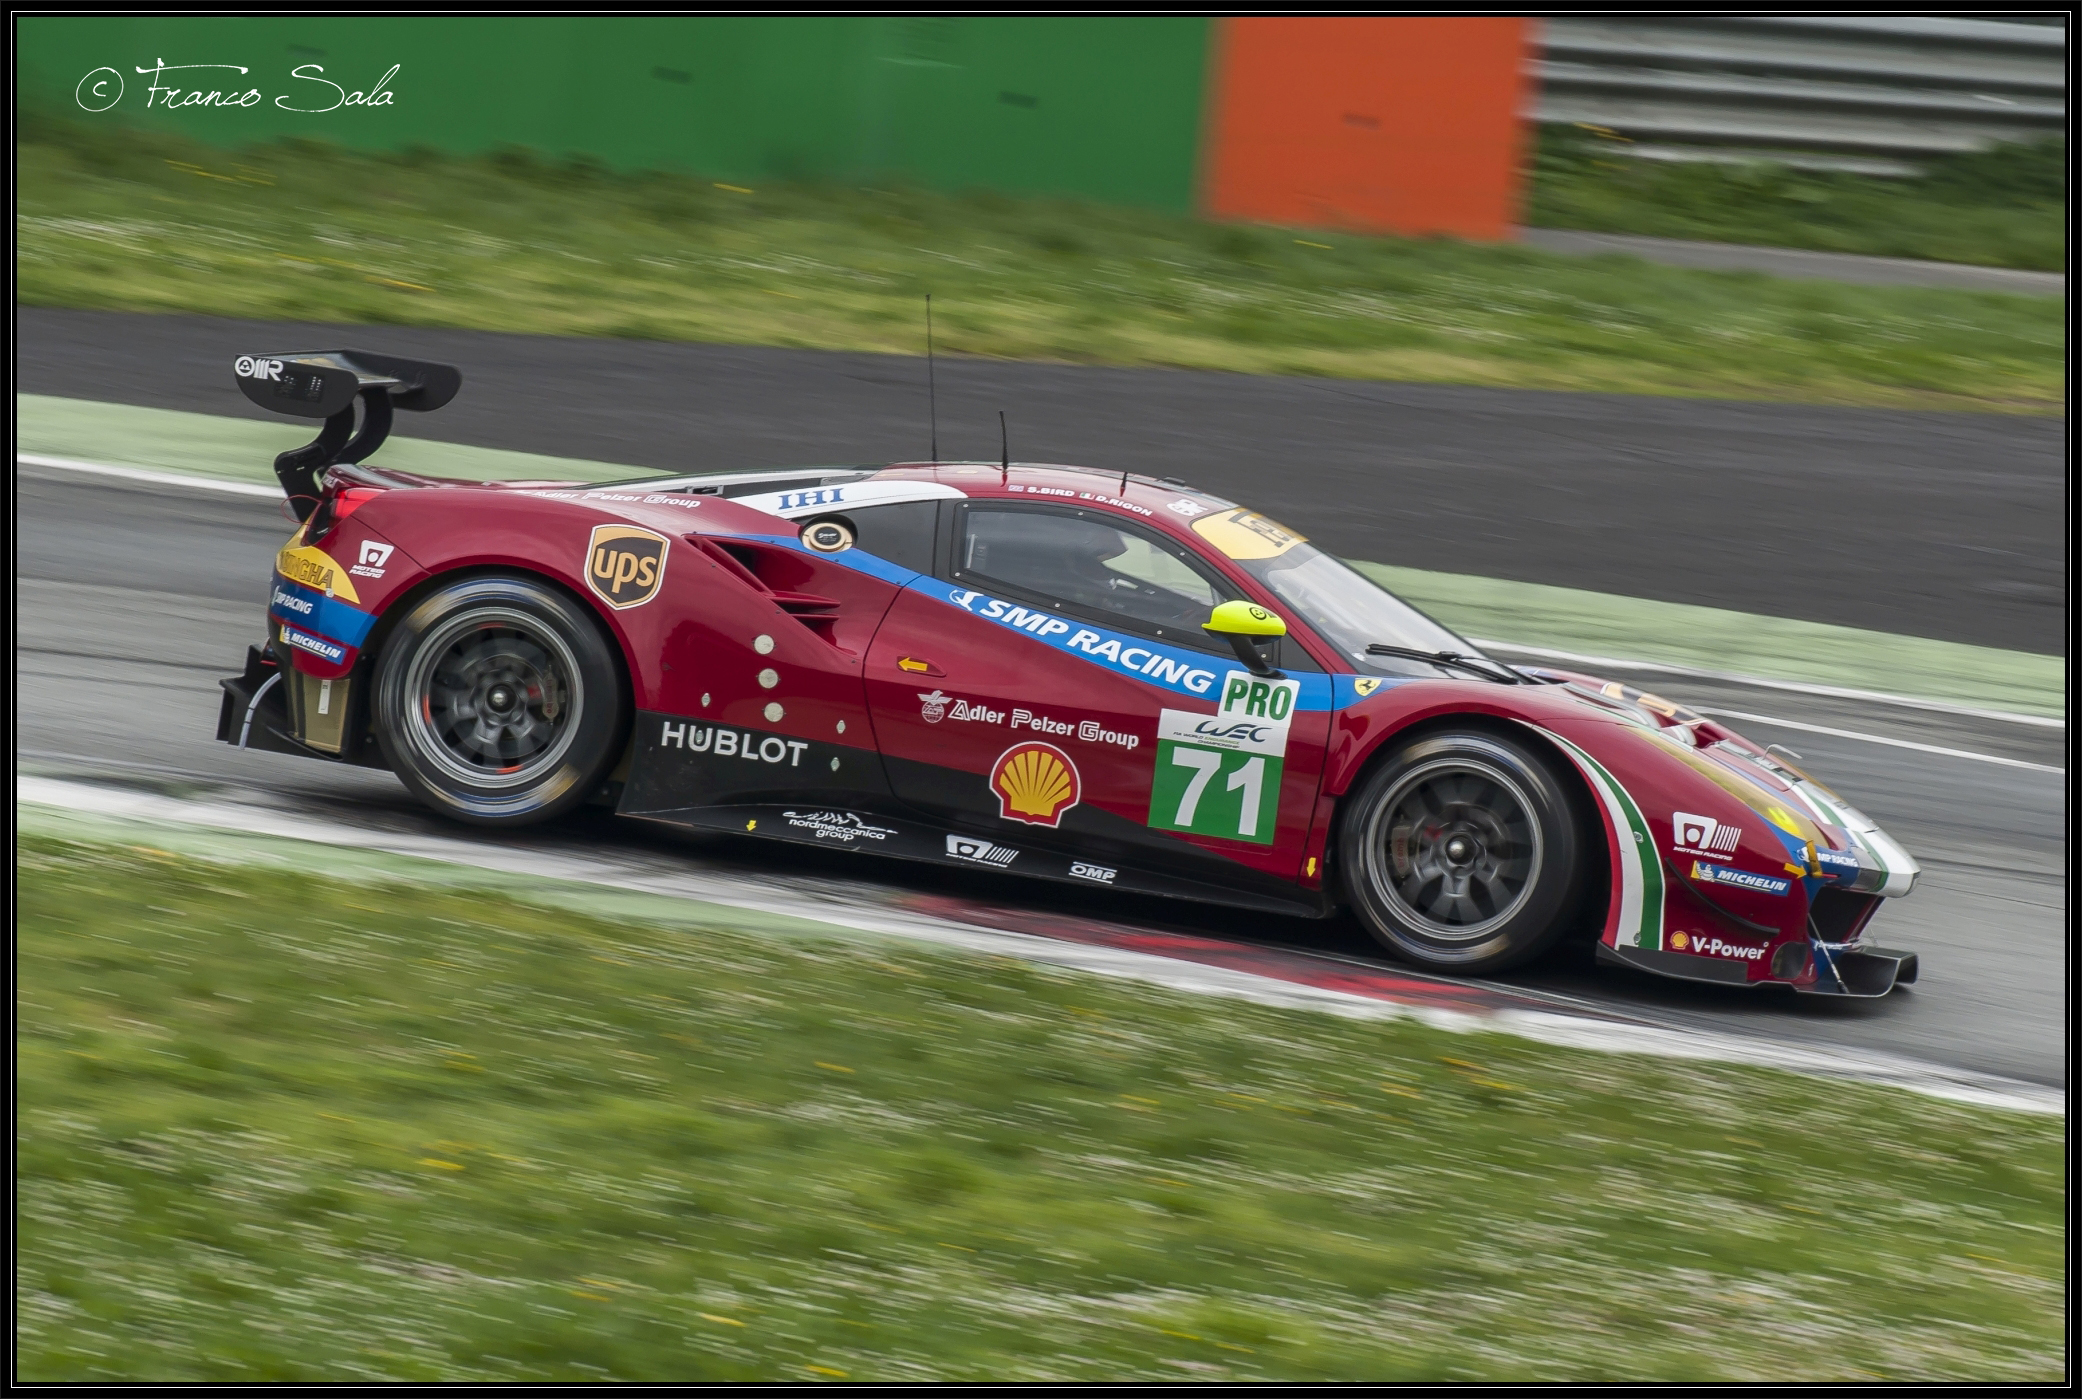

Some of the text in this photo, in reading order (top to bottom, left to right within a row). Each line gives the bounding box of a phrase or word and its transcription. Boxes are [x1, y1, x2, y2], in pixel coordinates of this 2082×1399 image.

[643, 494, 702, 508] Group
[778, 488, 844, 510] IHI
[1027, 487, 1075, 497] S.BIRD
[593, 548, 657, 594] ups
[290, 632, 342, 658] MICHELIN
[979, 600, 1216, 693] SMP RACING
[1223, 678, 1292, 721] PRO
[948, 700, 1005, 724] Adler
[1011, 709, 1074, 736] Pelzer
[1078, 721, 1139, 749] Group
[1194, 721, 1273, 743] WEC
[661, 721, 808, 767] HUBLOT
[1172, 746, 1265, 836] 71
[788, 819, 886, 840] nordmeccanica
[815, 829, 855, 842] group
[1070, 864, 1117, 881] OMP
[1717, 869, 1787, 892] MICHELIN
[1691, 936, 1766, 961] V-Power
